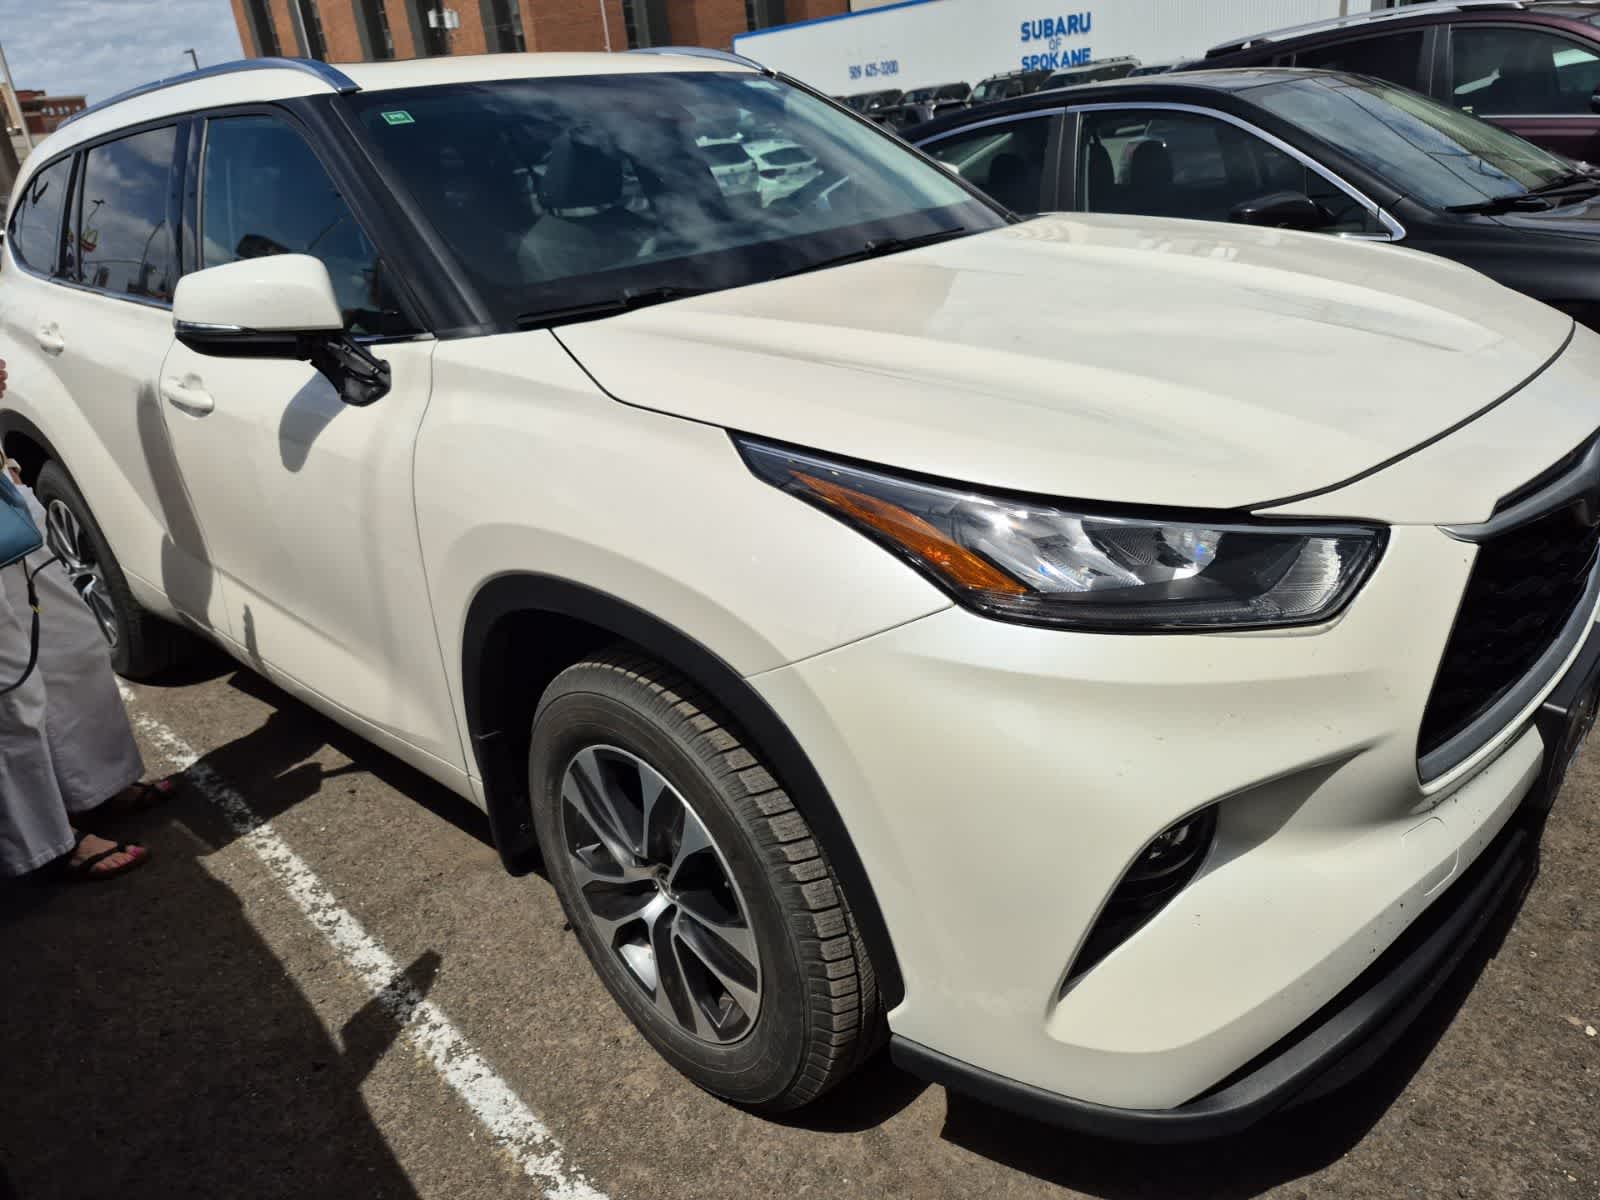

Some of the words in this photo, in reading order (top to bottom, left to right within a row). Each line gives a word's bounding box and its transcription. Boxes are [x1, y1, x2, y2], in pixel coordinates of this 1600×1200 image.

[1021, 12, 1091, 42] SUBARU
[1048, 37, 1062, 50] OF
[1022, 47, 1091, 72] SPOKANE
